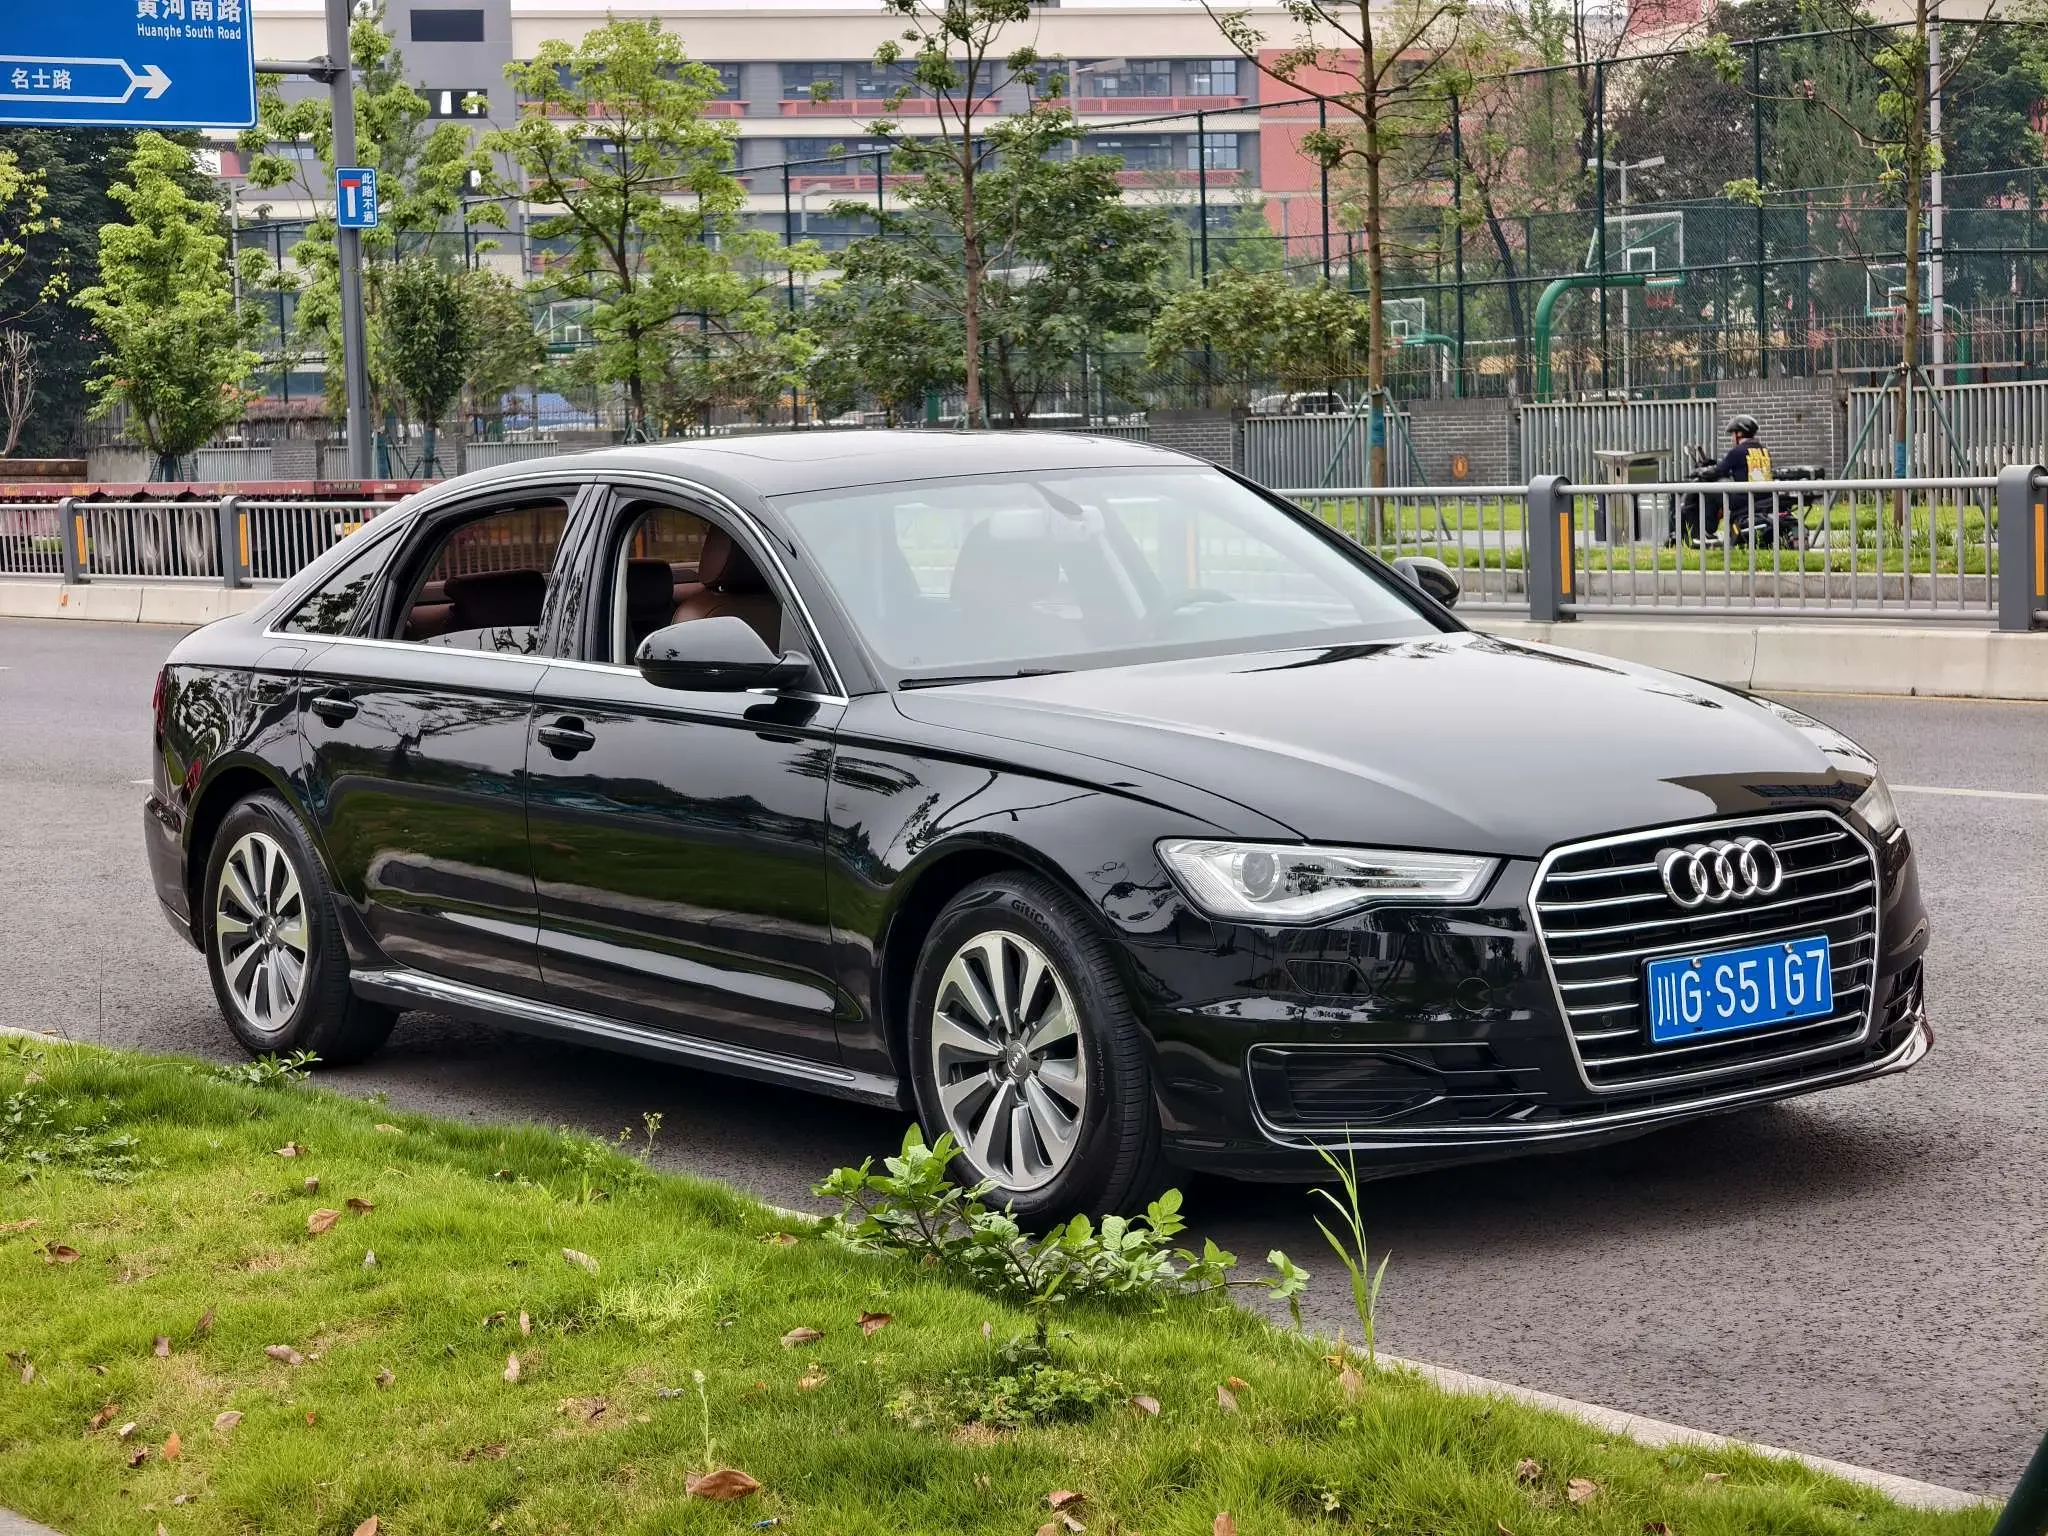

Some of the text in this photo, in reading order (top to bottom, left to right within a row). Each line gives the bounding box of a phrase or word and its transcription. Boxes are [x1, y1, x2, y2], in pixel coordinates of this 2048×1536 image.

[136, 0, 242, 22] 黄河南路
[137, 23, 241, 40] Huanghe South Road
[11, 68, 72, 90] 名士路
[361, 172, 374, 223] 此路不通
